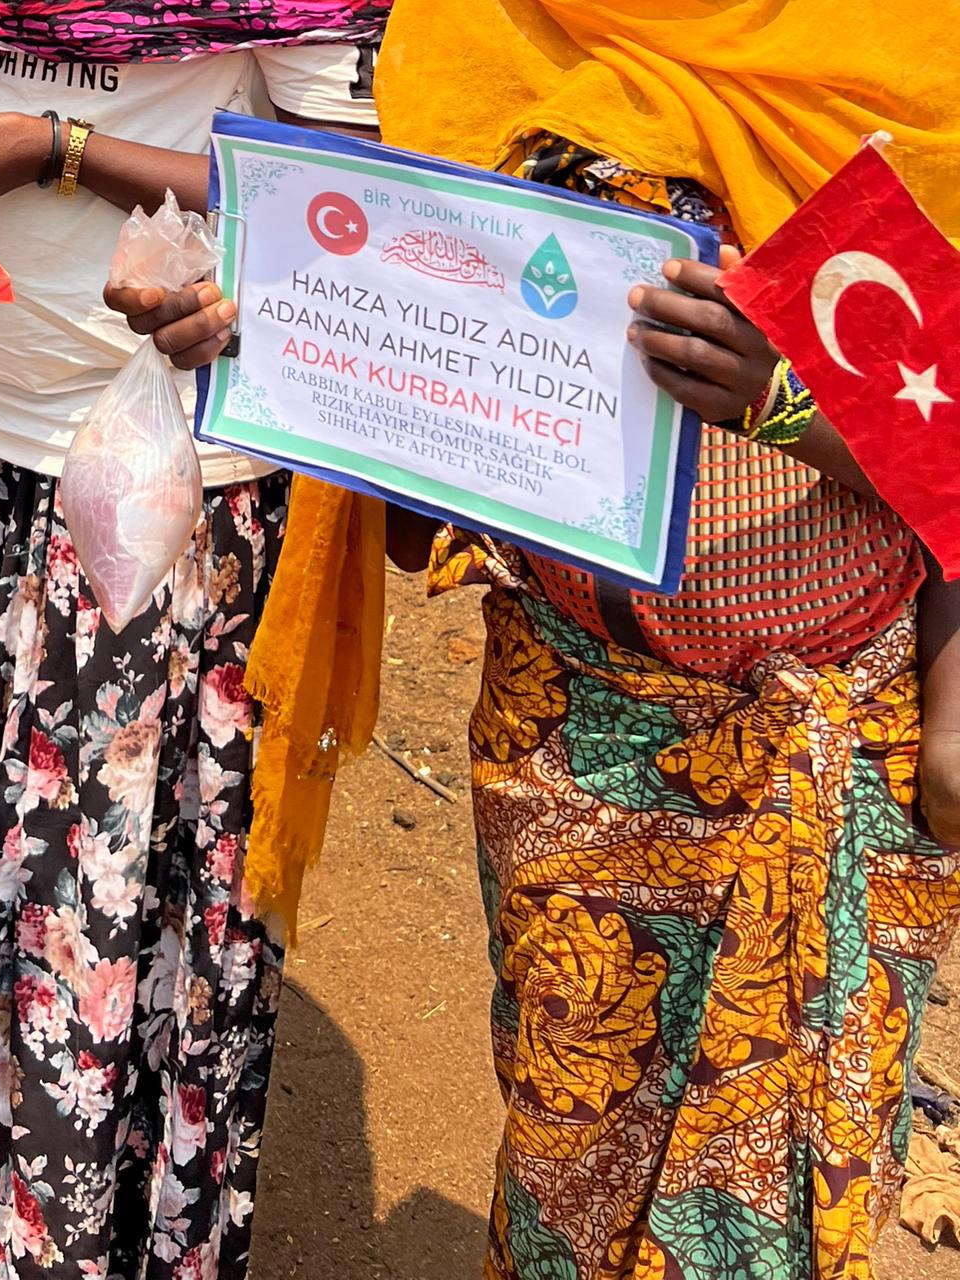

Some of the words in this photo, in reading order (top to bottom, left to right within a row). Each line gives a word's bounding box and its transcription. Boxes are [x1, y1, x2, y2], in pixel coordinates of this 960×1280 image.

[363, 188, 391, 208] BİR
[399, 196, 462, 226] YUDUM
[470, 210, 524, 240] İYİLİK
[257, 297, 370, 347] ADANAN
[379, 332, 481, 377] AHMET
[490, 361, 618, 419] YILDIZIN
[292, 270, 387, 318] HAMZA
[396, 299, 489, 345] YILDIZ
[496, 328, 593, 373] ADINA
[282, 336, 358, 379] ADAK
[367, 361, 501, 422] KURBANI
[512, 404, 583, 447] KEÇİ
[318, 409, 381, 440] SIHHAT
[383, 429, 406, 449] VE
[352, 387, 408, 416] KABUL
[552, 449, 592, 474] BOL
